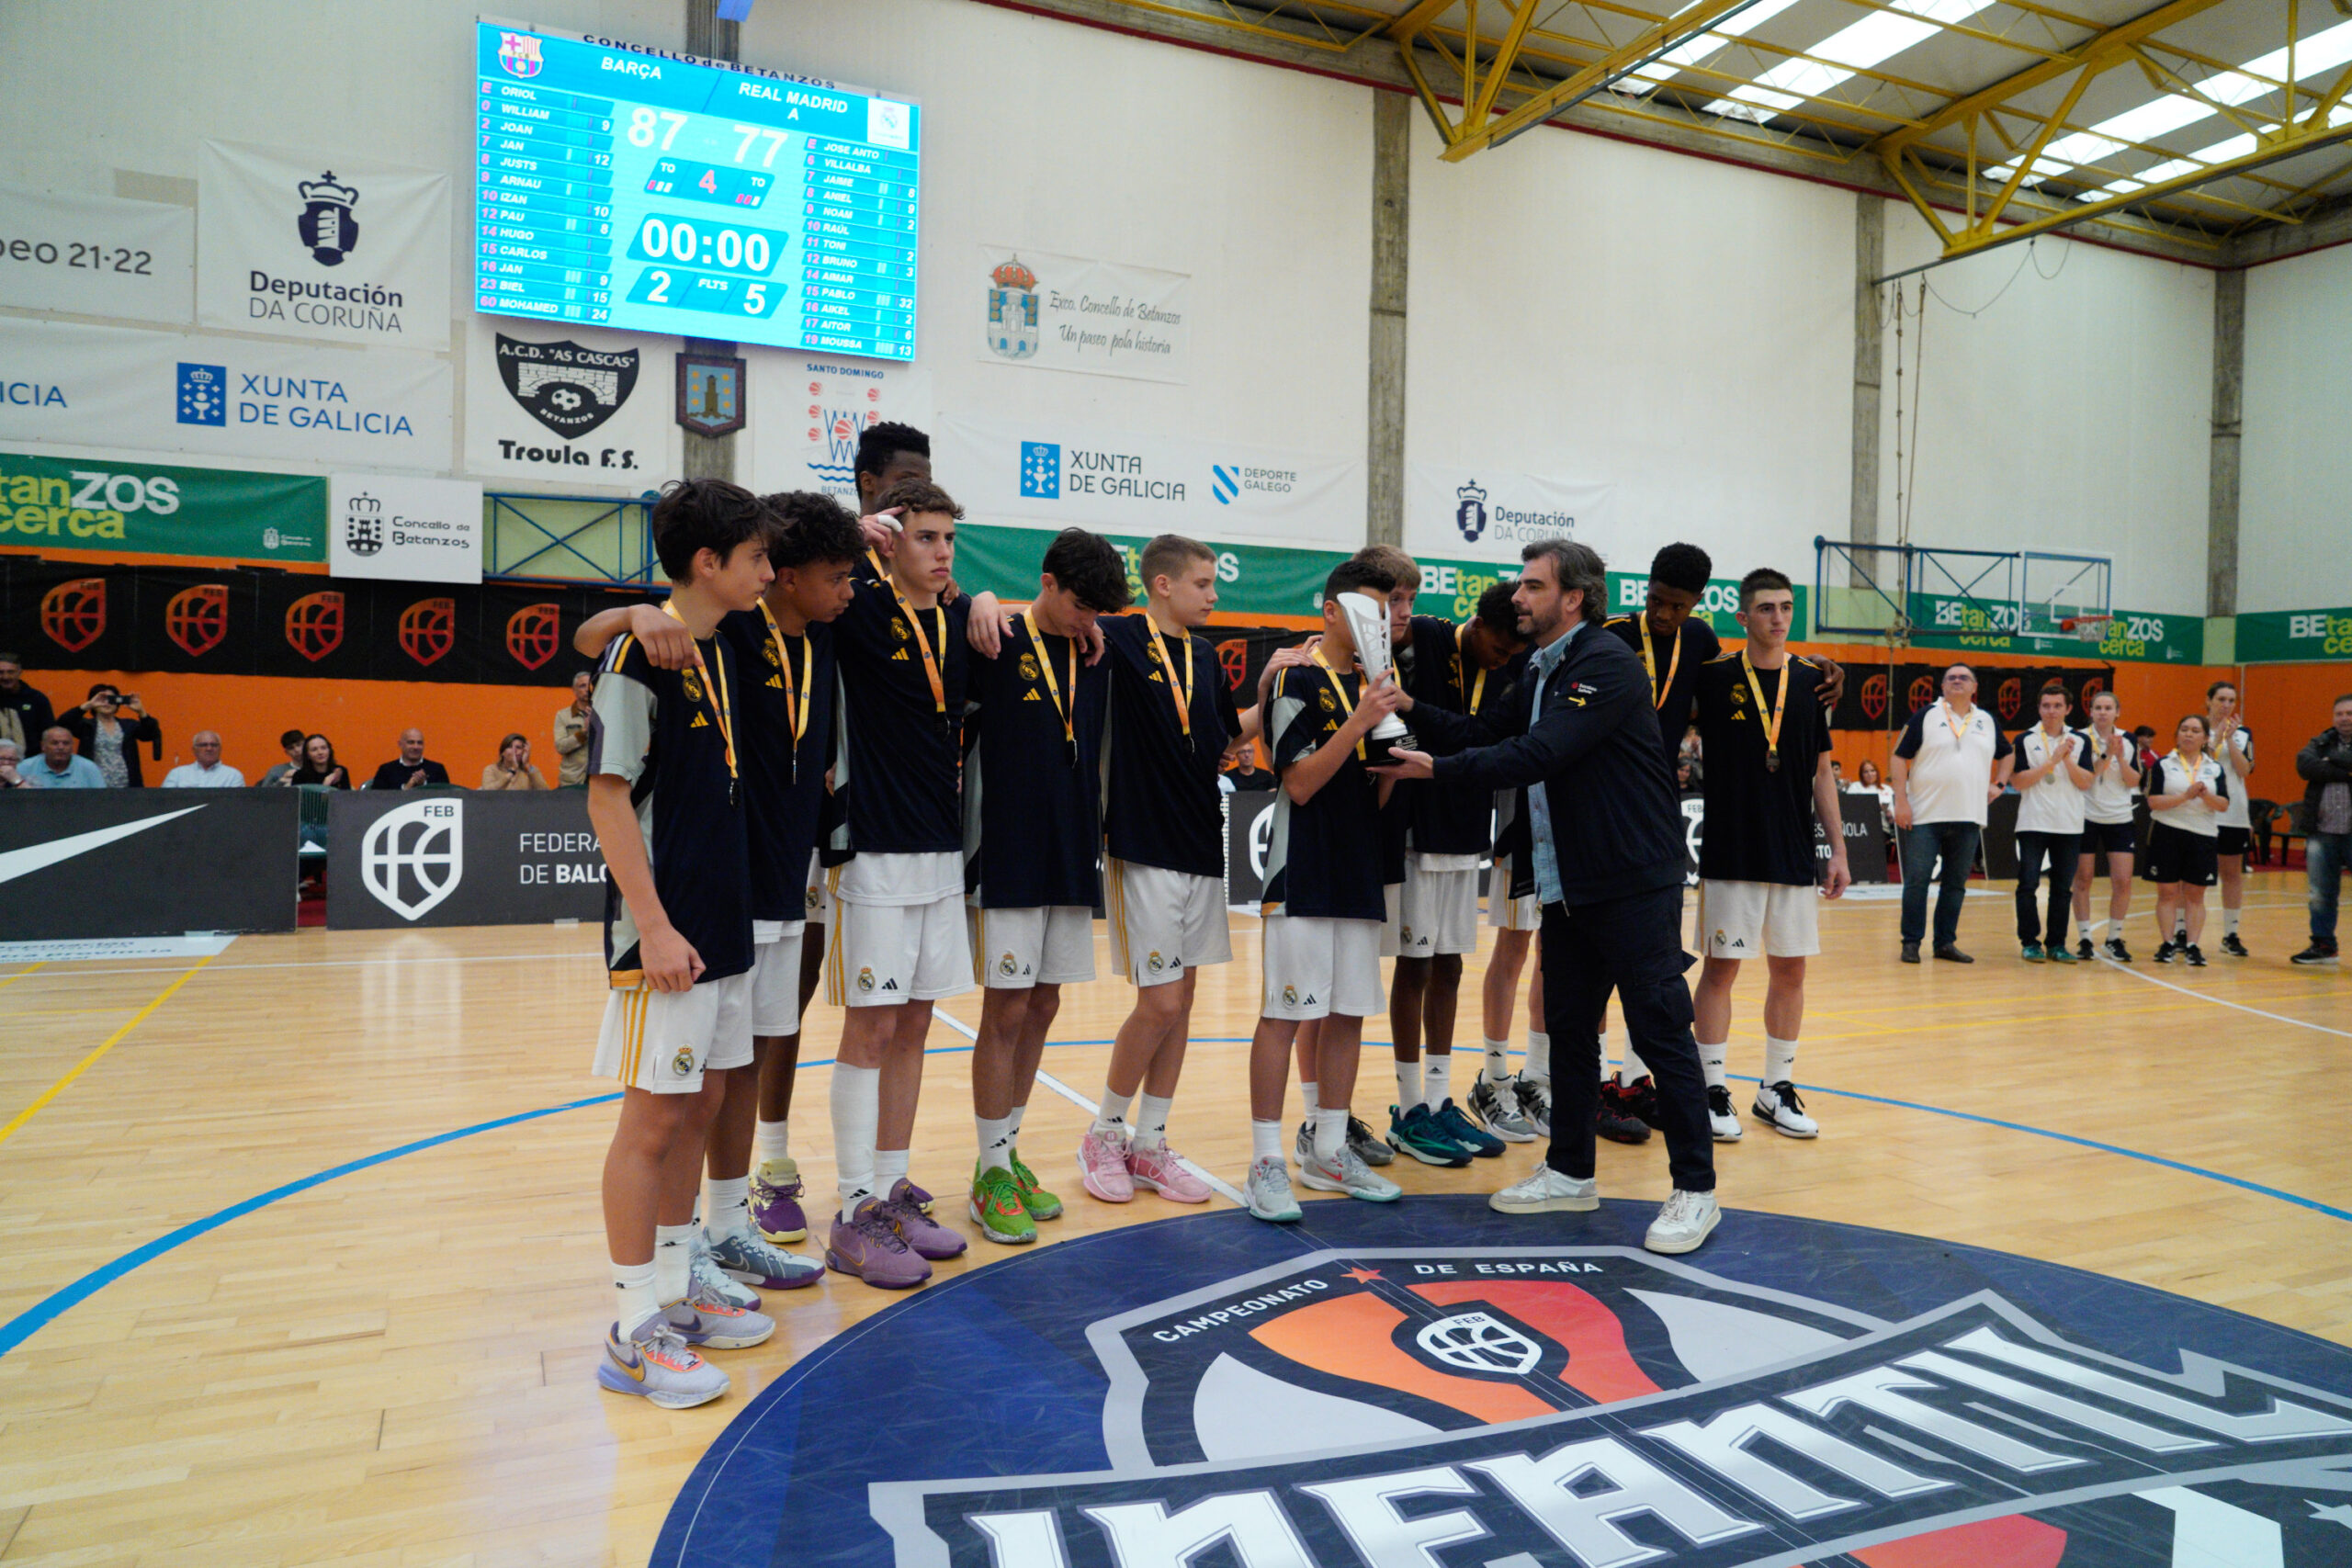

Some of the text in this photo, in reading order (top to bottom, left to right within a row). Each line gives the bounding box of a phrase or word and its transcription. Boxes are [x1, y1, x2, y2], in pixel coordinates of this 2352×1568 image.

[582, 34, 836, 90] CONCELLO de BETANZOS
[601, 56, 662, 81] BARÇA
[481, 82, 537, 100] E ORIOL
[739, 82, 848, 115] REAL MADRID
[481, 100, 610, 131] 0 WILLIAM 9
[787, 107, 800, 121] A
[481, 118, 533, 135] 2 JOAN
[628, 107, 688, 152] 87
[482, 135, 609, 165] 7 JAN 12
[733, 123, 788, 168] 77
[824, 142, 850, 154] JOSE
[853, 148, 879, 159] ANTO
[481, 153, 537, 170] 8 JUSTS
[661, 162, 676, 174] TO
[808, 155, 871, 174] 6 VILLALBA
[481, 172, 541, 188] 9 ARNAU
[698, 169, 718, 194] 4
[752, 176, 766, 188] TO
[808, 171, 815, 181] 7
[908, 188, 915, 197] 8
[482, 190, 609, 217] 10 IZAN 10
[807, 187, 814, 197] 8
[908, 204, 915, 214] 9
[482, 208, 608, 234] 12 PAU 8
[807, 204, 814, 214] 9
[908, 220, 915, 230] 2
[808, 220, 820, 231] 10
[481, 226, 534, 240] 14 HUGO
[481, 243, 548, 260] 15 CARLOS
[641, 219, 770, 272] 00:00
[807, 237, 914, 262] 11 TONI 2
[481, 261, 608, 286] 16 JAN 9
[806, 270, 854, 284] 14 AIMAR
[807, 254, 913, 277] 12 BRUNO 3
[250, 270, 403, 308] Deputación
[481, 278, 607, 303] 23 BIEL 15
[647, 270, 672, 303] 2
[698, 278, 729, 291] FLTS
[481, 296, 607, 320] 60 MOHAMED 24
[743, 283, 767, 314] 5
[806, 286, 913, 309] 15 PABLO 32
[250, 297, 402, 333] DA CORUÑA
[806, 302, 912, 325] 16 AIKEL 2
[1080, 295, 1120, 317] Concello
[1124, 298, 1135, 318] de
[1137, 303, 1181, 325] Betanzos
[805, 318, 912, 340] 17 AITOR 6
[1059, 324, 1170, 356] Un paseo pola historia
[499, 344, 635, 367] A.C.D. "AS CASCAS"
[805, 334, 911, 356] 19 MOUSSA 13
[807, 364, 884, 378] SANTO DOMINGO
[241, 374, 348, 403] XUNTA
[240, 402, 413, 437] DE GALICIA
[539, 408, 594, 424] BETANZOS
[498, 439, 639, 469] Troula F.S.
[1070, 450, 1142, 475] XUNTA
[1244, 468, 1297, 483] DEPORTE
[1244, 479, 1292, 494] GALEGO
[1069, 474, 1185, 502] DE GALICIA
[392, 516, 450, 530] Concello
[1496, 506, 1575, 528] Deputación
[392, 531, 469, 549] Betanzos
[1495, 525, 1513, 540] DA
[2098, 637, 2145, 657] cerca
[424, 805, 454, 818] FEB
[520, 863, 548, 884] DE
[1414, 1259, 1604, 1275] DE ESPAÑA
[1151, 1279, 1329, 1344] CAMPEONATO
[1453, 1314, 1487, 1327] FEB
